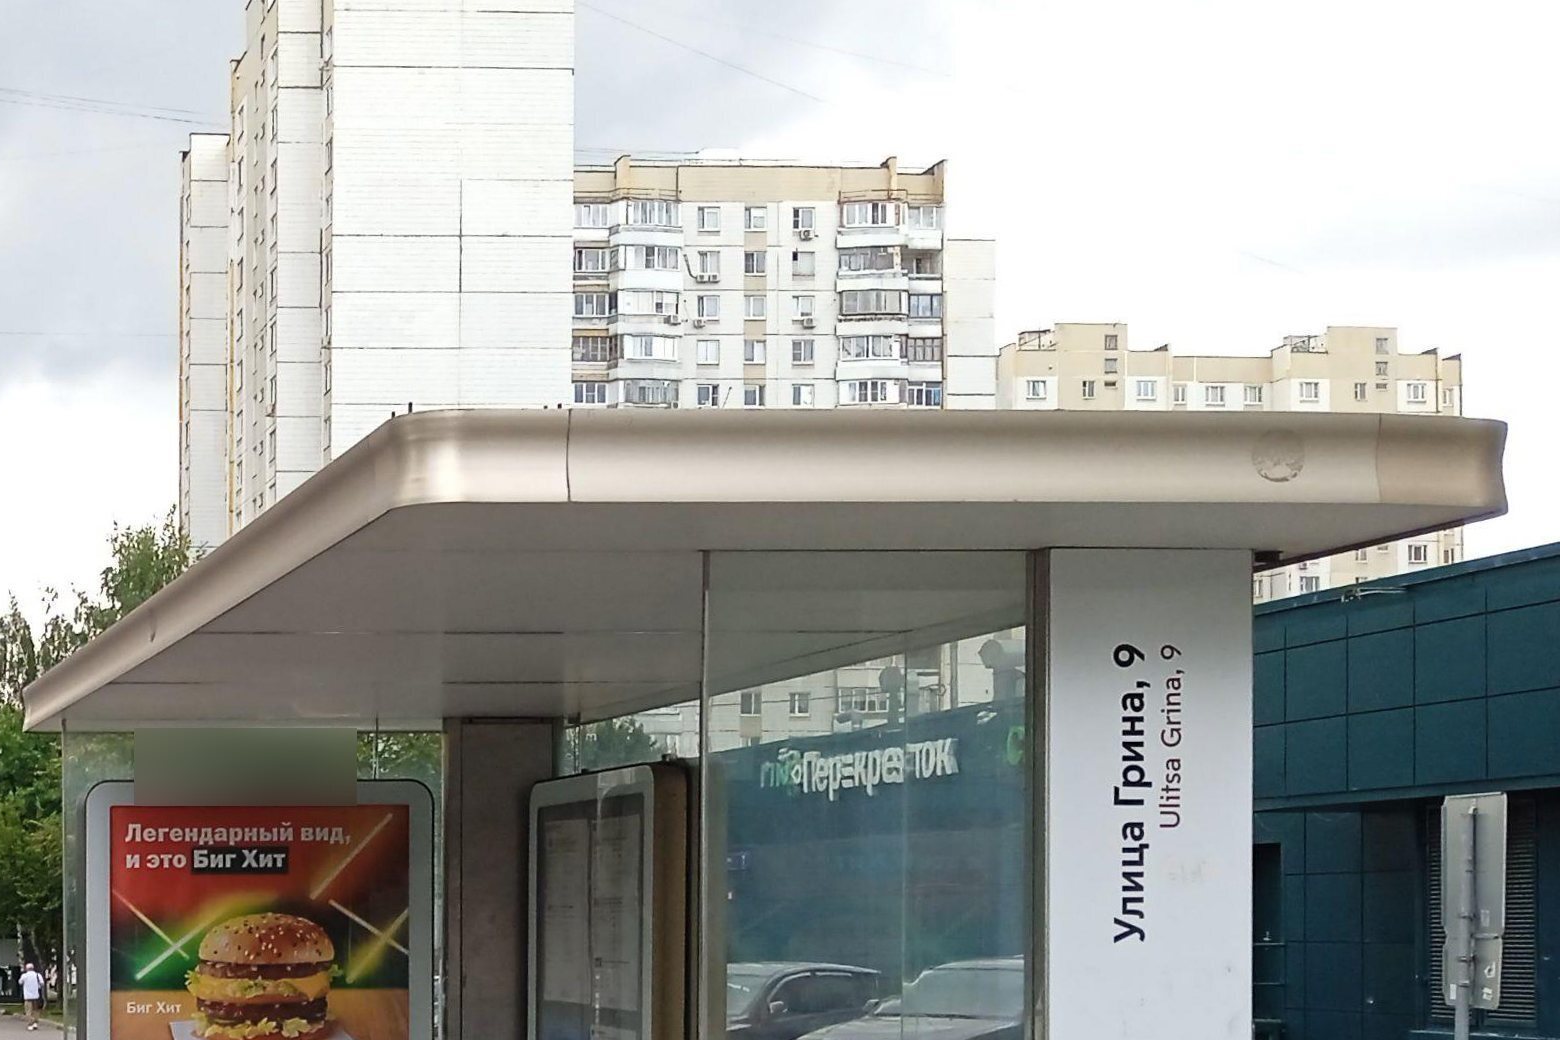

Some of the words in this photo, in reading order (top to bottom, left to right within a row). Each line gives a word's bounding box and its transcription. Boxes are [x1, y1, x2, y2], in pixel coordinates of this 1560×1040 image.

[1113, 642, 1146, 669] 9
[1160, 644, 1183, 661] 9
[1160, 668, 1185, 748] Grina,
[1113, 679, 1153, 807] Грина,
[1158, 757, 1181, 829] Ulitsa
[124, 822, 294, 846] Легендарный
[300, 825, 351, 845] вид,
[125, 854, 140, 869] и
[146, 854, 187, 869] это
[193, 849, 237, 869] Биг
[241, 849, 286, 869] Хит
[1113, 820, 1150, 943] Улица
[126, 1001, 153, 1014] Биг
[156, 1001, 182, 1014] Хит
